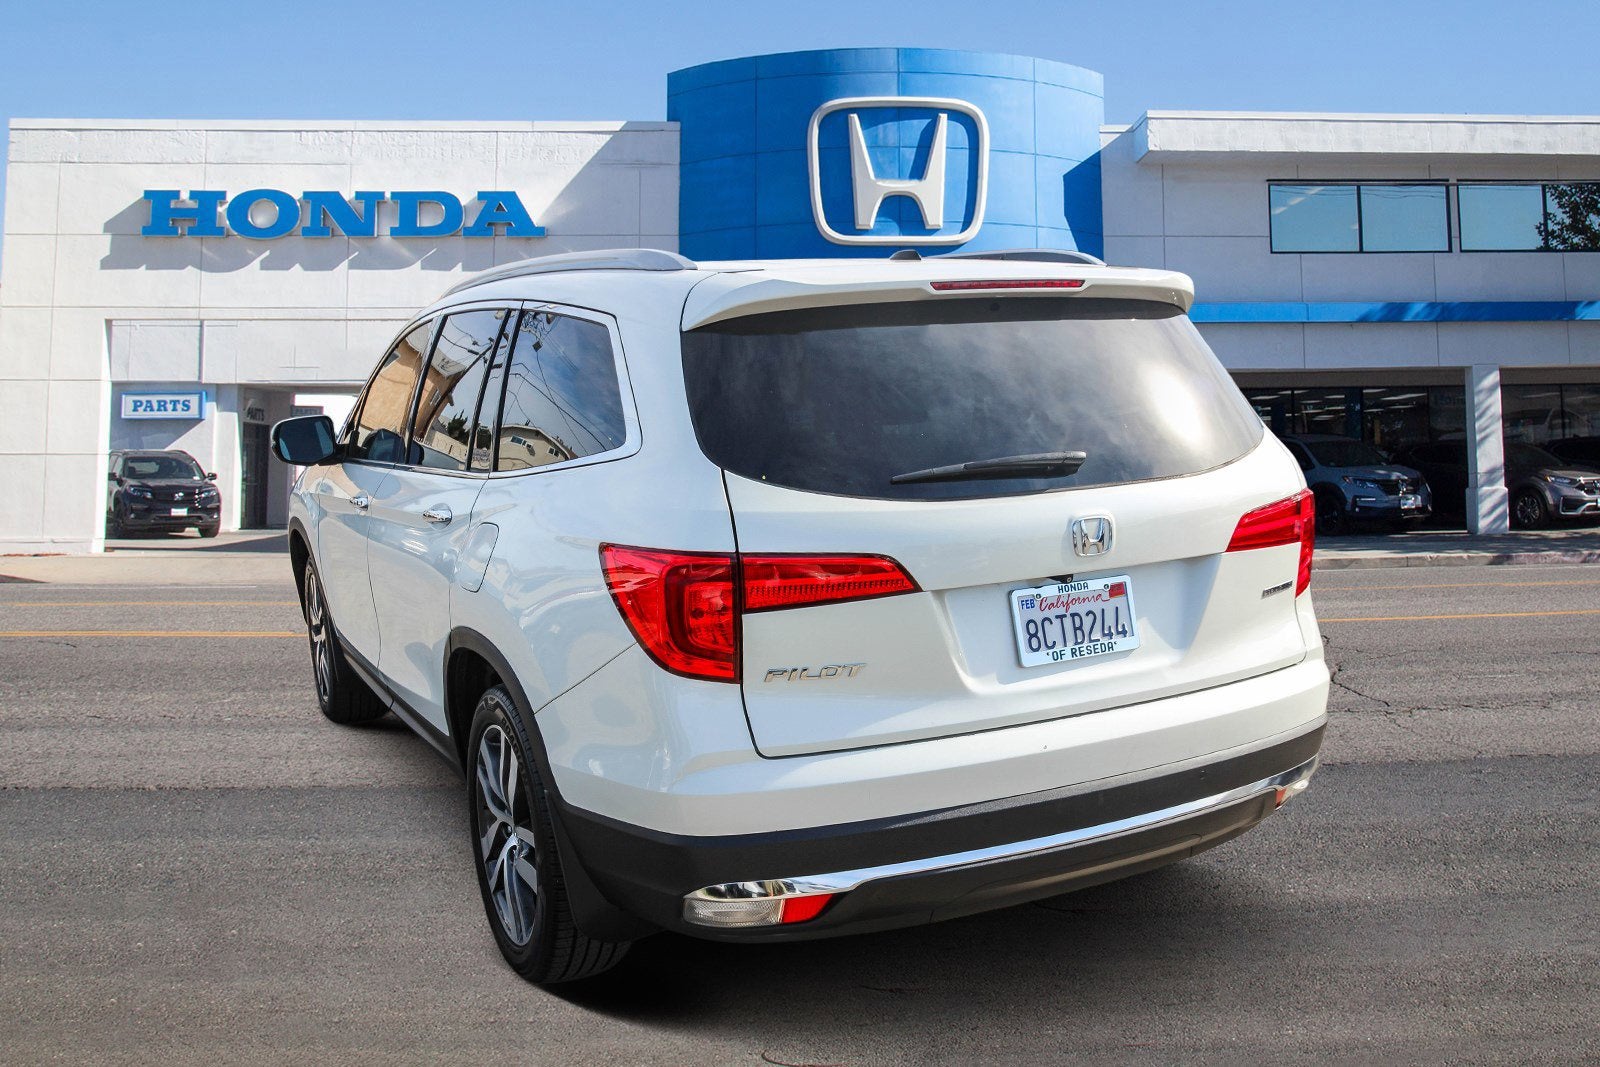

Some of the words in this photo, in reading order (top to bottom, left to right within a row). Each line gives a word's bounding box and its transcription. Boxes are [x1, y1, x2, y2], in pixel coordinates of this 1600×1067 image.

[141, 188, 546, 239] HONDA
[131, 399, 191, 412] PARTS
[1057, 582, 1089, 593] HONDA
[1020, 598, 1036, 610] FEB
[1039, 593, 1110, 613] California
[1025, 606, 1128, 653] 8CTB244
[1070, 641, 1114, 658] RESEDA
[763, 662, 867, 682] PILOT
